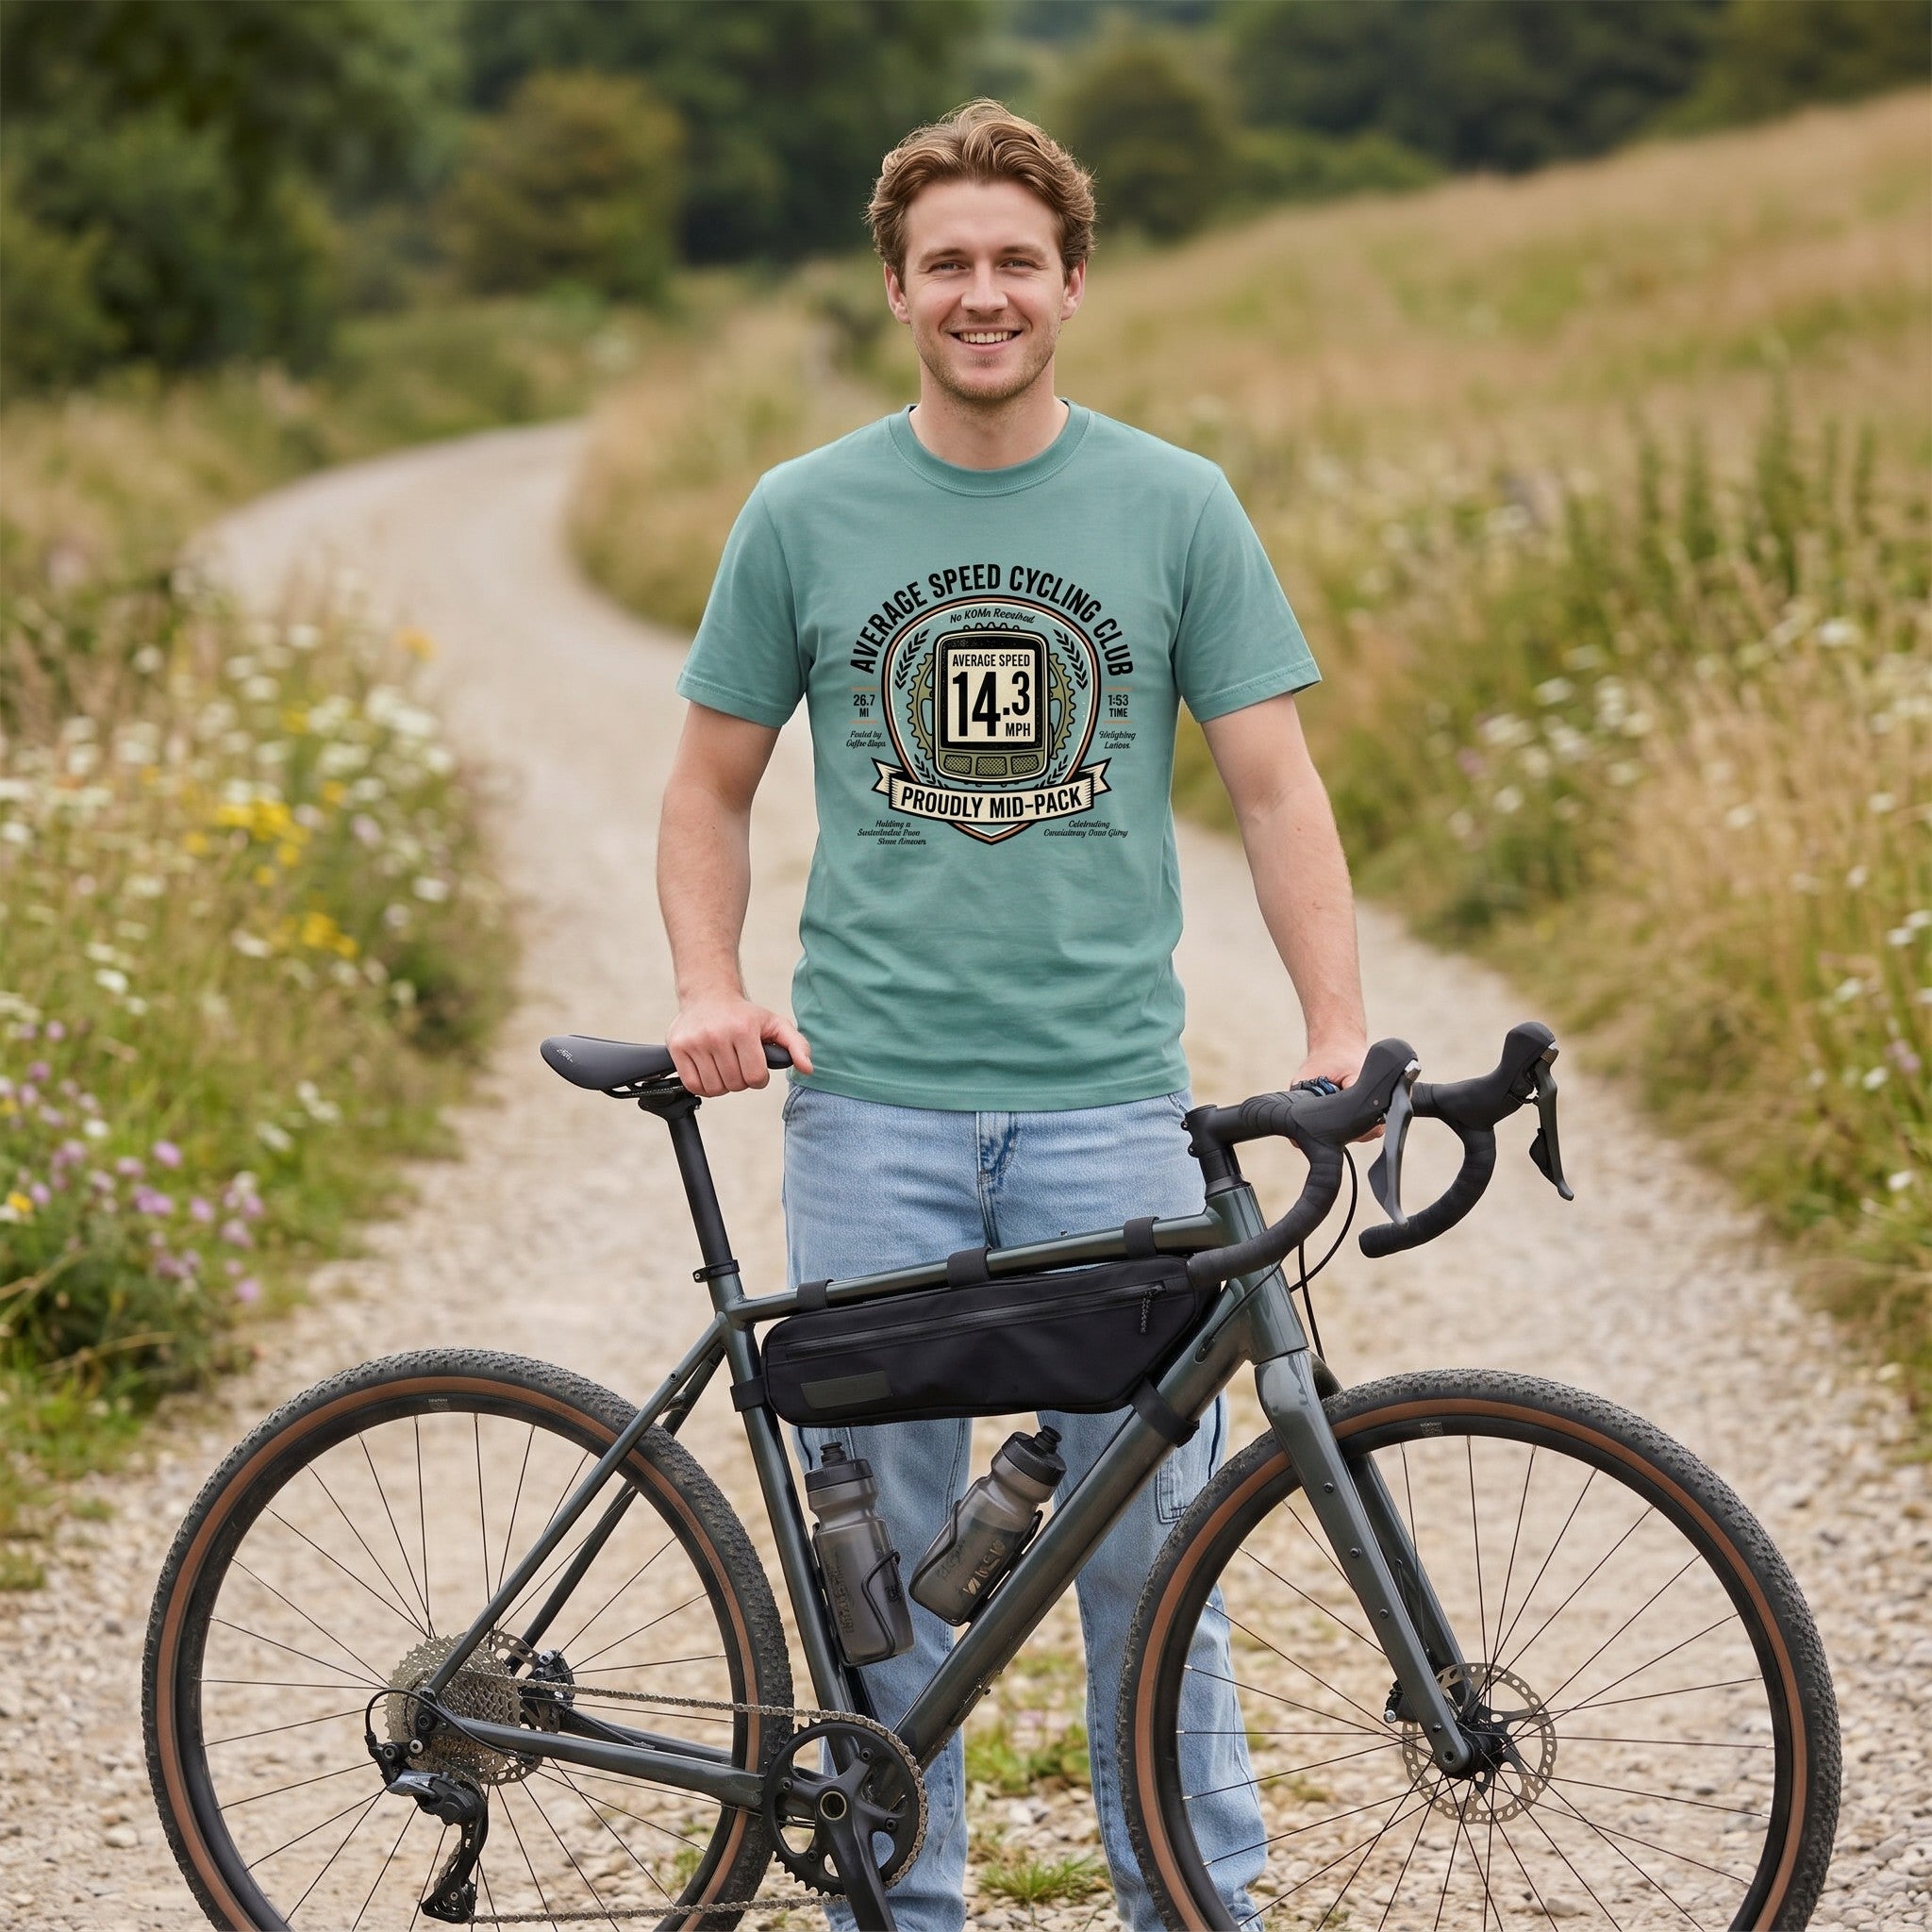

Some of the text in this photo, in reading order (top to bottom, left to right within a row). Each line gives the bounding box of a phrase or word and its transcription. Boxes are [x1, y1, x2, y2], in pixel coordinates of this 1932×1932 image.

[850, 564, 1134, 676] AVERAGE SPEED CYCLING CLUB
[950, 614, 962, 624] No
[952, 654, 1030, 667] AVERAGE SPEED
[853, 693, 875, 707] 26.7
[952, 671, 1030, 737] 14.3
[1108, 693, 1129, 707] 1:53
[859, 708, 869, 718] MI
[1108, 708, 1128, 718] TIME
[1005, 723, 1031, 737] MPH
[901, 786, 1083, 819] PROUDLY MID-PACK
